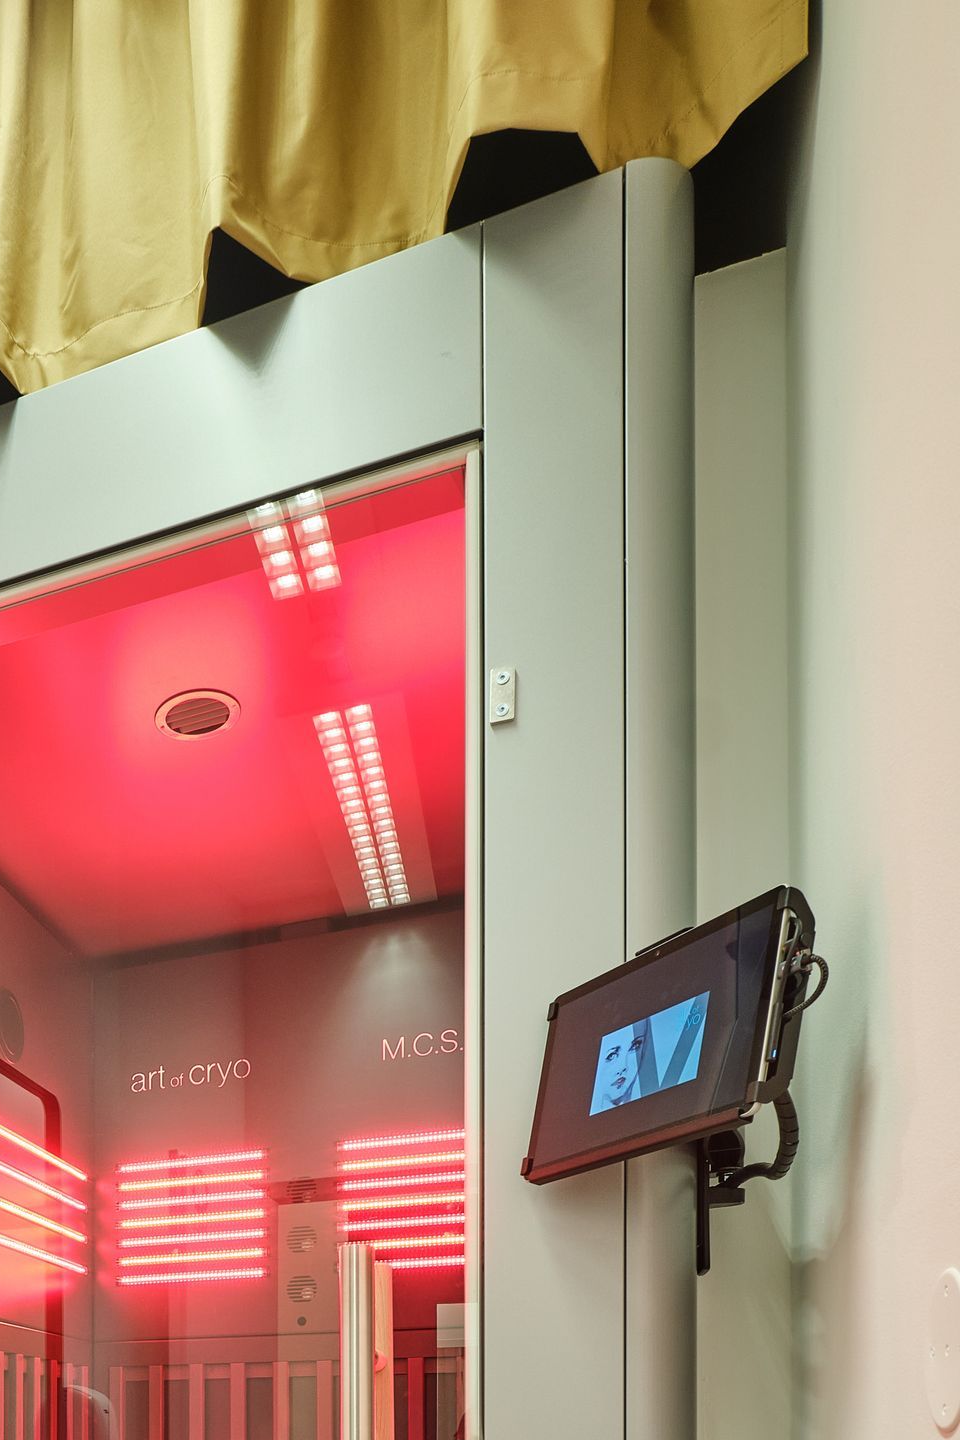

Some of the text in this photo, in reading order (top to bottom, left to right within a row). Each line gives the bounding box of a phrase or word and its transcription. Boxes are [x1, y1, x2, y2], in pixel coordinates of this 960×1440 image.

[382, 1029, 464, 1061] M.C.S.
[131, 1058, 251, 1093] art of cryo
